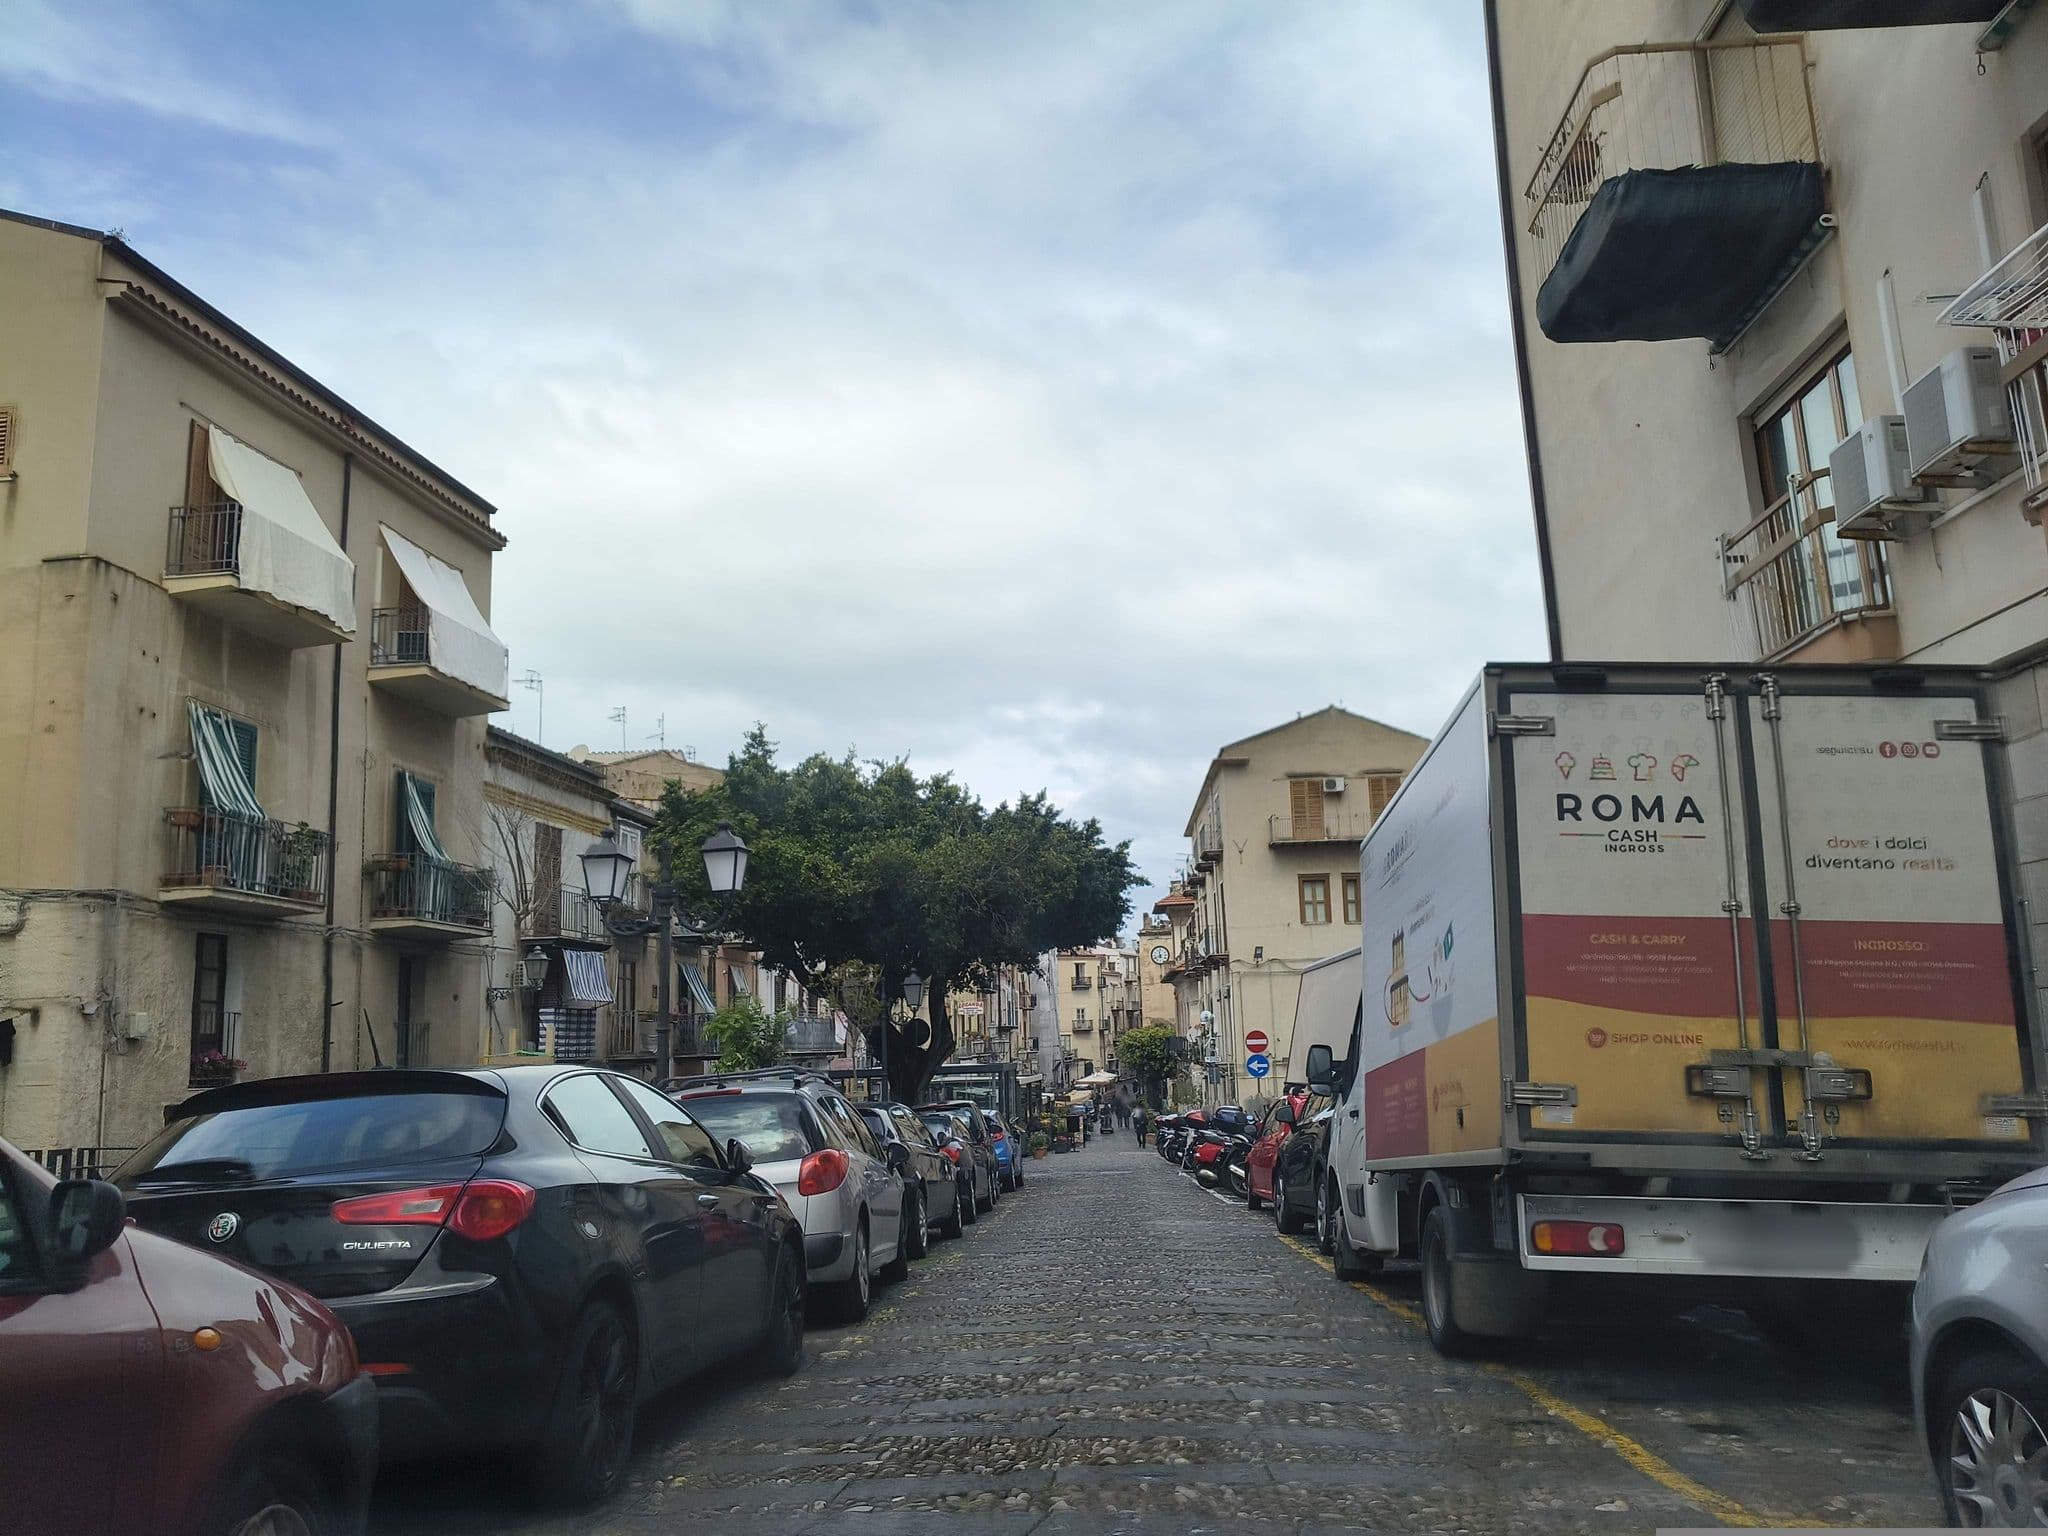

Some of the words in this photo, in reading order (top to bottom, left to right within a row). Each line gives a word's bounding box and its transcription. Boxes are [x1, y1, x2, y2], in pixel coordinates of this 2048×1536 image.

[1556, 793, 1705, 824] ROMA
[1607, 829, 1658, 843] CASH
[1604, 844, 1665, 853] INGROSS
[1826, 836, 1869, 849] dove
[1884, 837, 1927, 850] dolci
[1805, 854, 1895, 870] diventano
[1590, 934, 1627, 944] CASH
[1631, 935, 1640, 944] &
[1643, 935, 1686, 945] CARRY
[1854, 939, 1923, 951] INGROSSO
[1611, 1033, 1648, 1043] SHOP
[1652, 1034, 1704, 1045] ONLINE
[343, 1241, 411, 1250] GIULIETTA
